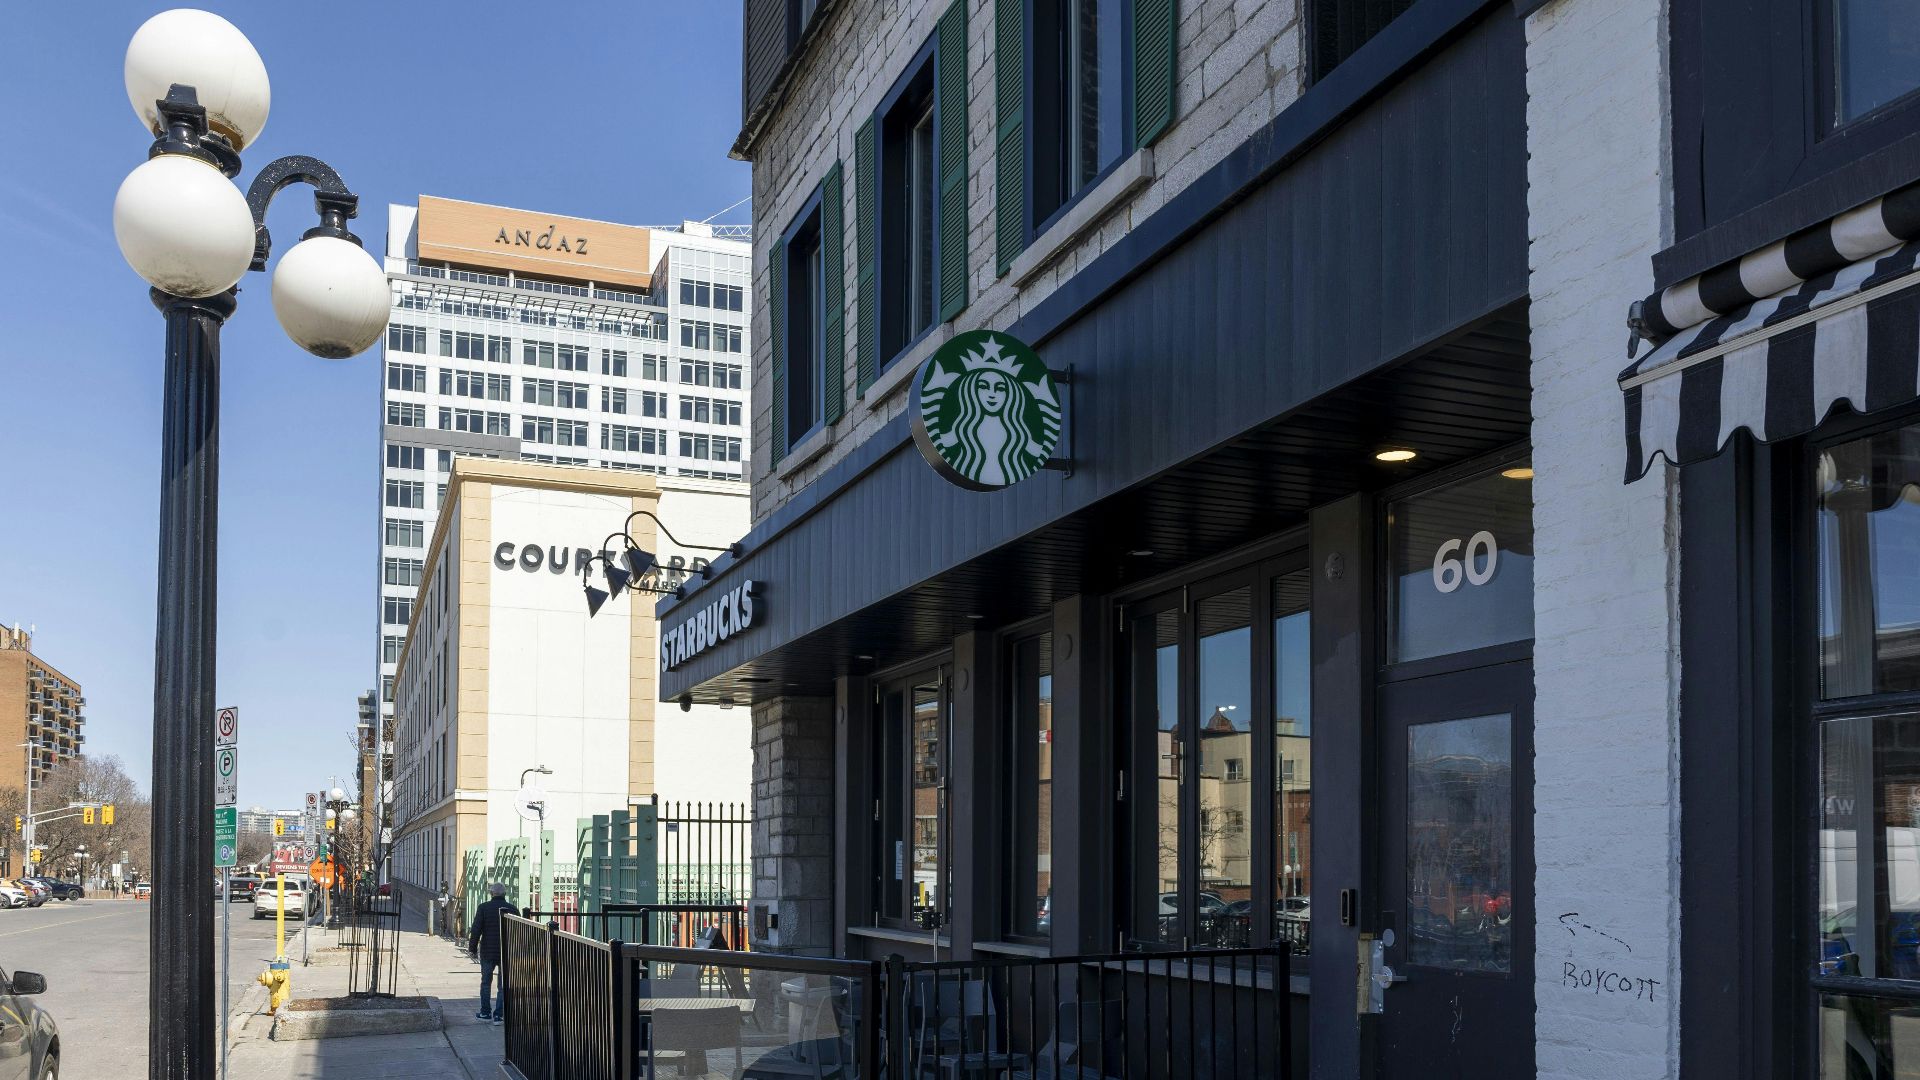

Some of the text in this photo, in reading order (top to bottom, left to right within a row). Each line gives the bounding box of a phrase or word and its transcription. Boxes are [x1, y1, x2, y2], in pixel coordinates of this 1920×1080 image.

[494, 541, 710, 577] COURTARD
[1433, 530, 1498, 593] 60
[661, 579, 753, 673] STARBUCKS
[1563, 962, 1661, 1002] BOYCOTT
